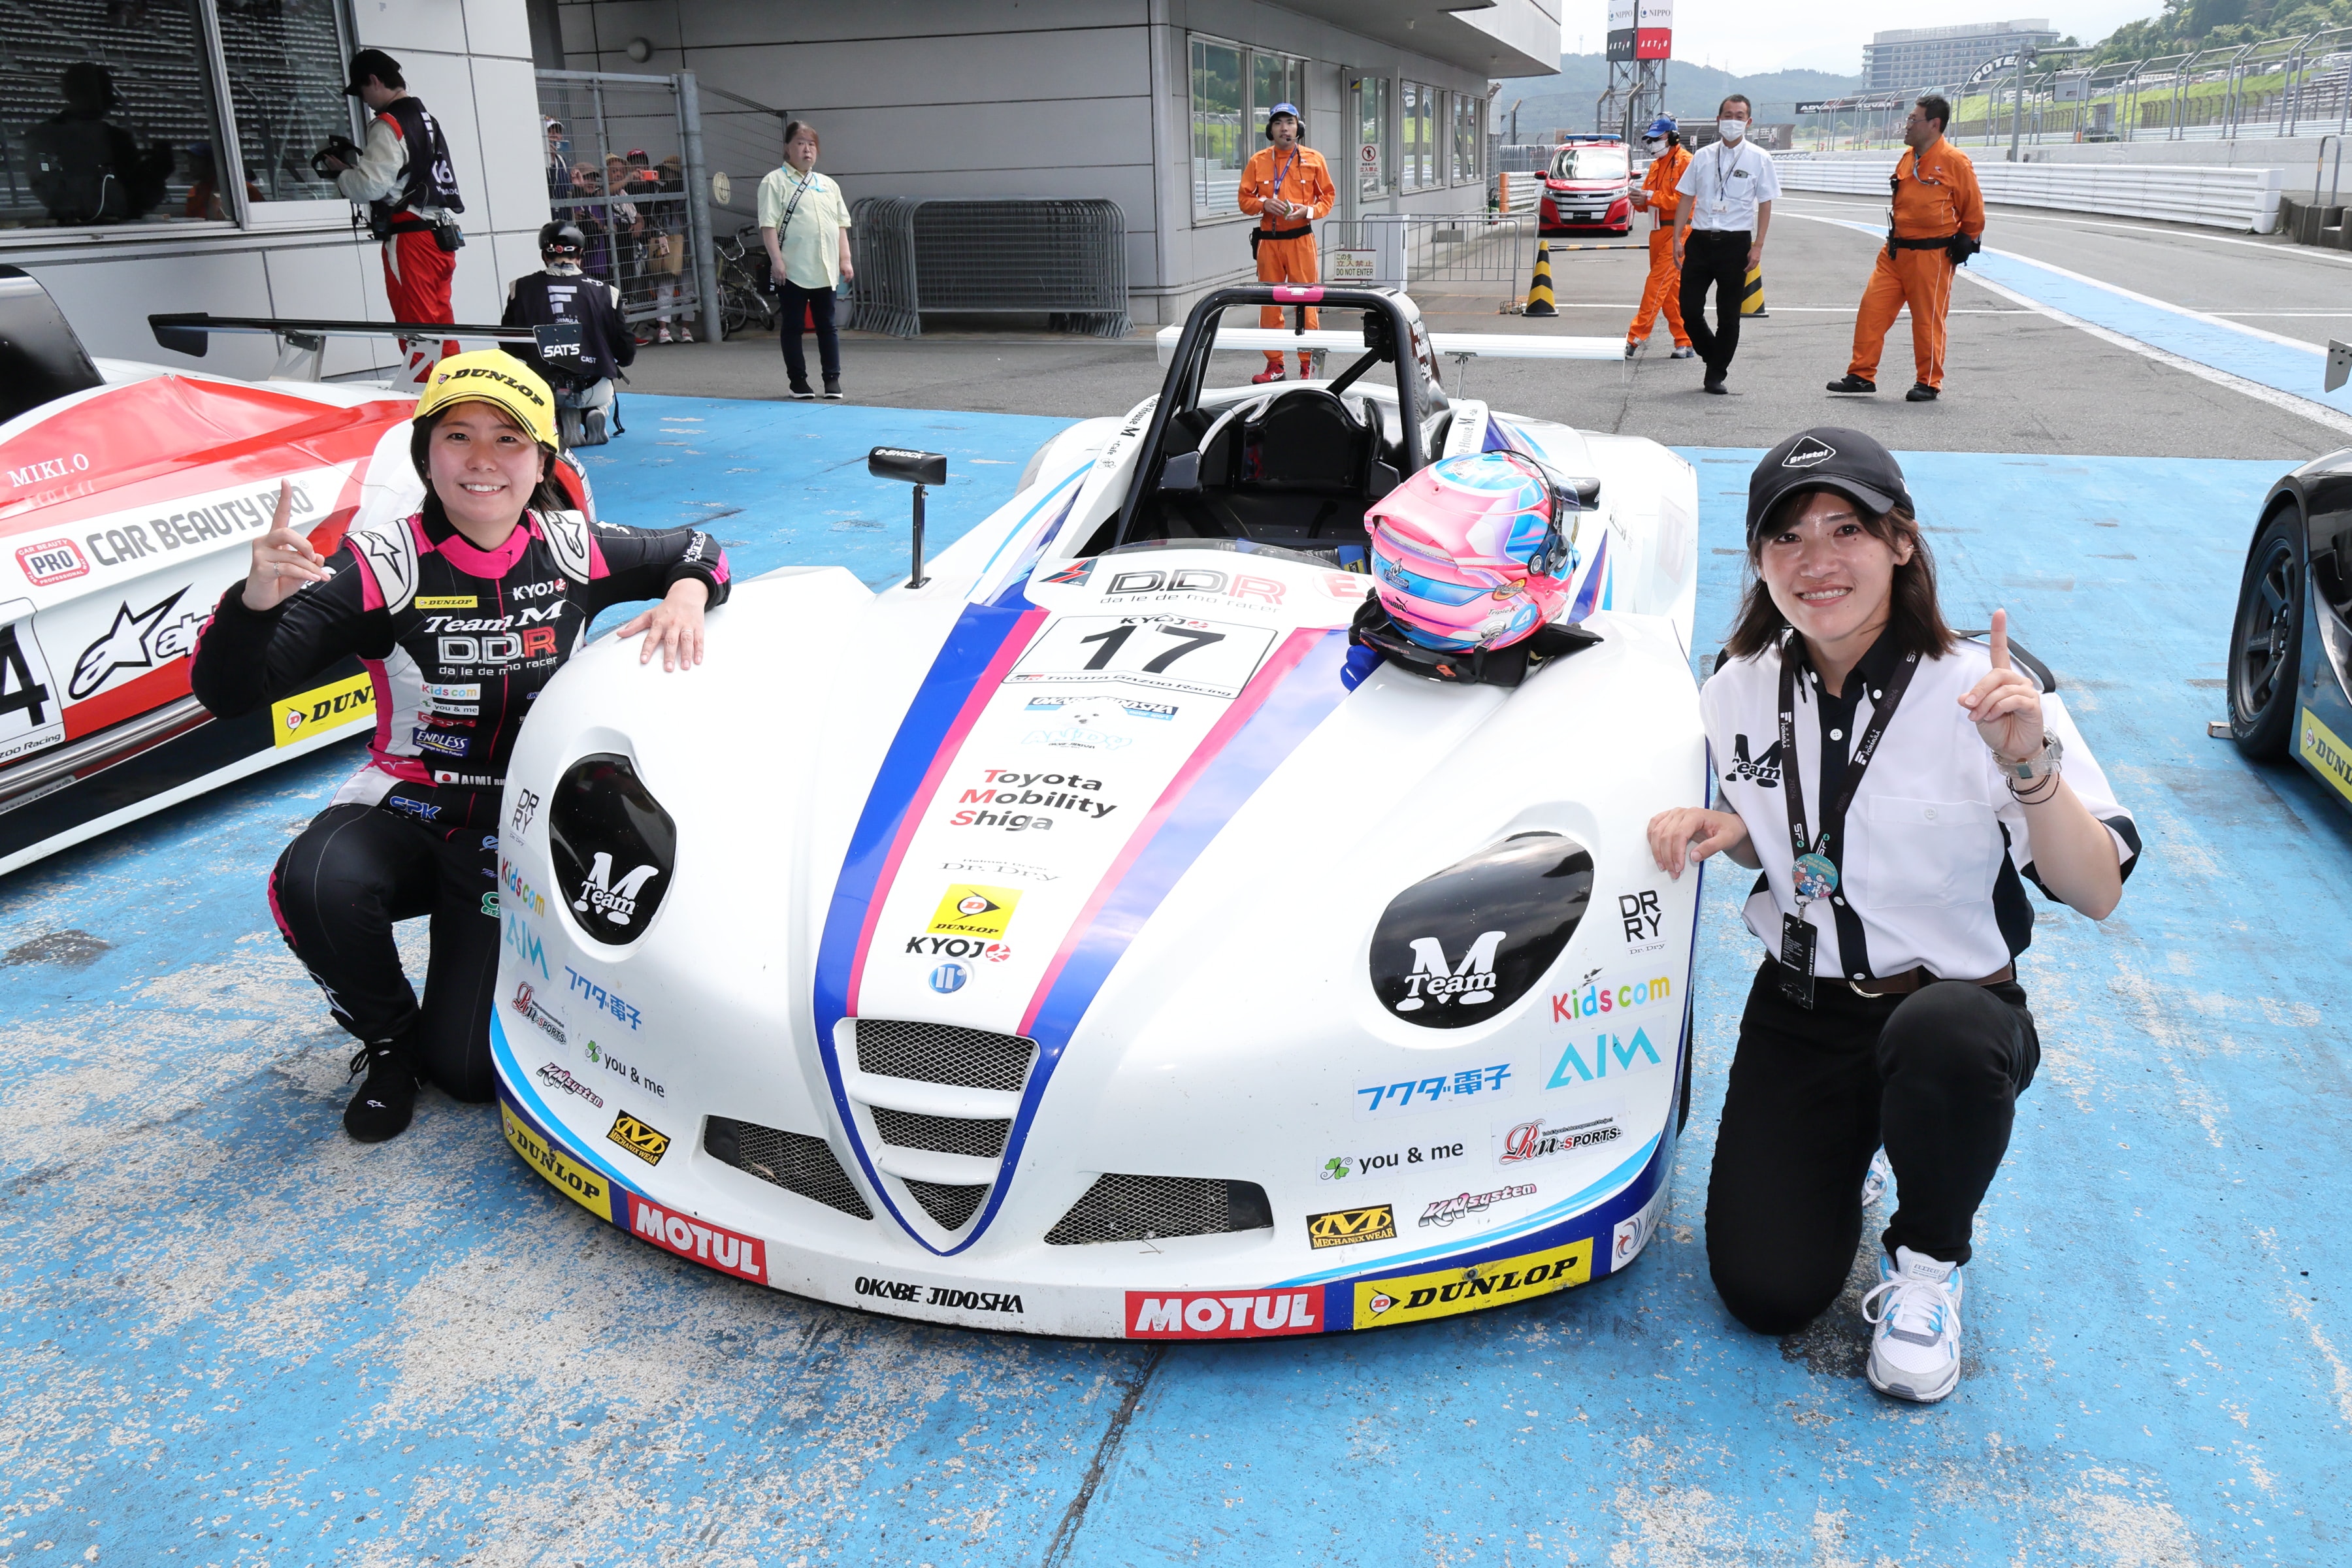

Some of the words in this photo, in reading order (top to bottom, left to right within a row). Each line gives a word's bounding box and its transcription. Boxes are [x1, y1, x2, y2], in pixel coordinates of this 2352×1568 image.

[1616, 10, 1633, 19] NIPPO
[544, 343, 580, 358] SAT'S
[451, 368, 545, 407] DUNLOP
[875, 449, 926, 459] G-SHOCK
[1789, 449, 1829, 465] Bristol
[7, 453, 90, 488] MIKI.O
[86, 527, 158, 567] CAR
[148, 496, 262, 551] BEAUTY
[18, 546, 35, 556] CAR
[36, 539, 68, 551] BEAUTY
[30, 549, 74, 575] PRO
[39, 570, 84, 585] PROFESSIONAL
[424, 615, 514, 633] Team
[515, 599, 567, 627] M
[1187, 595, 1218, 604] mo
[1227, 600, 1281, 613] racer
[1079, 623, 1227, 674] 17
[439, 665, 455, 675] da
[461, 666, 473, 676] le
[478, 667, 494, 676] de
[499, 662, 521, 676] mo
[527, 656, 557, 668] racer
[1175, 683, 1233, 697] Racing
[24, 732, 61, 751] Racing
[416, 730, 468, 750] ENDLESS
[461, 774, 492, 785] AIMI
[984, 769, 1103, 792] Toyota
[517, 788, 540, 816] DR
[958, 789, 1118, 819] Mobility
[512, 808, 533, 835] RY
[949, 809, 1054, 832] Shiga
[938, 862, 986, 872] Dr.
[992, 866, 1062, 881] Dry
[574, 851, 660, 925] M
[580, 880, 636, 915] Team
[1618, 890, 1662, 919] DR
[933, 923, 1000, 935] DUNLOP
[1625, 912, 1663, 943] RY
[1629, 947, 1645, 955] Dr.
[1646, 943, 1666, 953] Dry
[1396, 930, 1507, 1011] M
[1404, 970, 1497, 998] Team
[564, 965, 642, 1031] フクダ電子
[604, 1053, 626, 1077] you
[630, 1067, 640, 1083] &
[644, 1077, 665, 1098] me
[1358, 1063, 1512, 1111] フクダ電子
[608, 1128, 640, 1154] MECHANIX
[638, 1150, 659, 1165] WEAR
[1358, 1151, 1399, 1175] you
[1406, 1147, 1423, 1164] &
[1430, 1143, 1464, 1161] me
[517, 1128, 600, 1200] DUNLOP
[635, 1201, 760, 1276] MOTUL
[1312, 1237, 1365, 1249] MECHANIX
[1365, 1227, 1395, 1241] WEAR
[855, 1276, 923, 1302] OKABE
[926, 1286, 1024, 1314] JIDOSHA
[1402, 1255, 1579, 1309] DUNLOP
[1134, 1293, 1316, 1331] MOTUL
